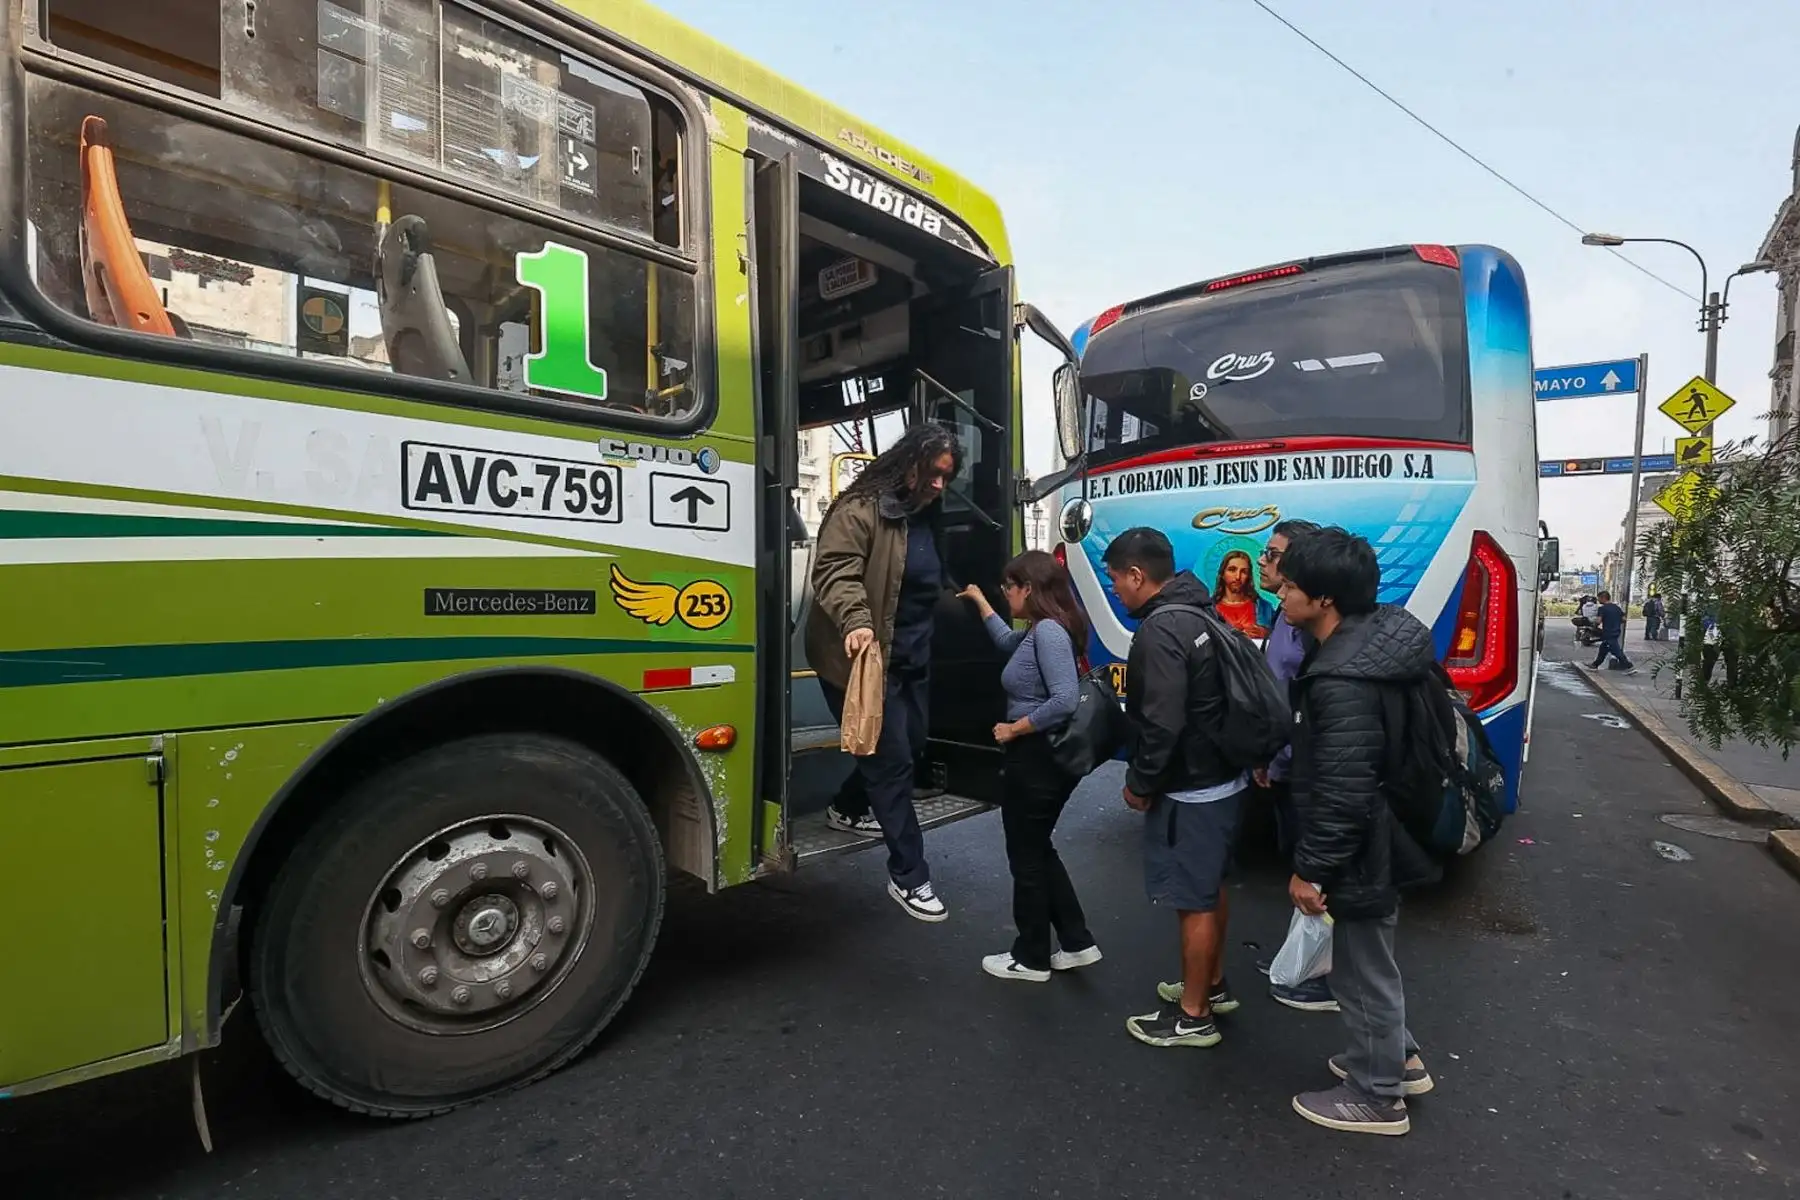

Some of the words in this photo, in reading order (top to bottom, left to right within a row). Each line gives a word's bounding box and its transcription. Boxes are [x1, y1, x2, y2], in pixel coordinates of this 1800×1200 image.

[824, 160, 942, 236] Subida
[514, 240, 608, 401] 1
[1206, 350, 1275, 380] Cruz
[1535, 376, 1586, 392] MAYO
[413, 450, 613, 516] AVC-759
[1089, 478, 1113, 500] E.T.
[1118, 466, 1183, 495] CORAZON
[1187, 464, 1209, 488] DE
[1213, 460, 1259, 486] JESUS
[1264, 457, 1287, 482] DE
[1292, 454, 1326, 480] SAN
[1331, 452, 1393, 479] DIEGO
[434, 591, 589, 613] Mercedes-Benz
[686, 594, 727, 617] 253
